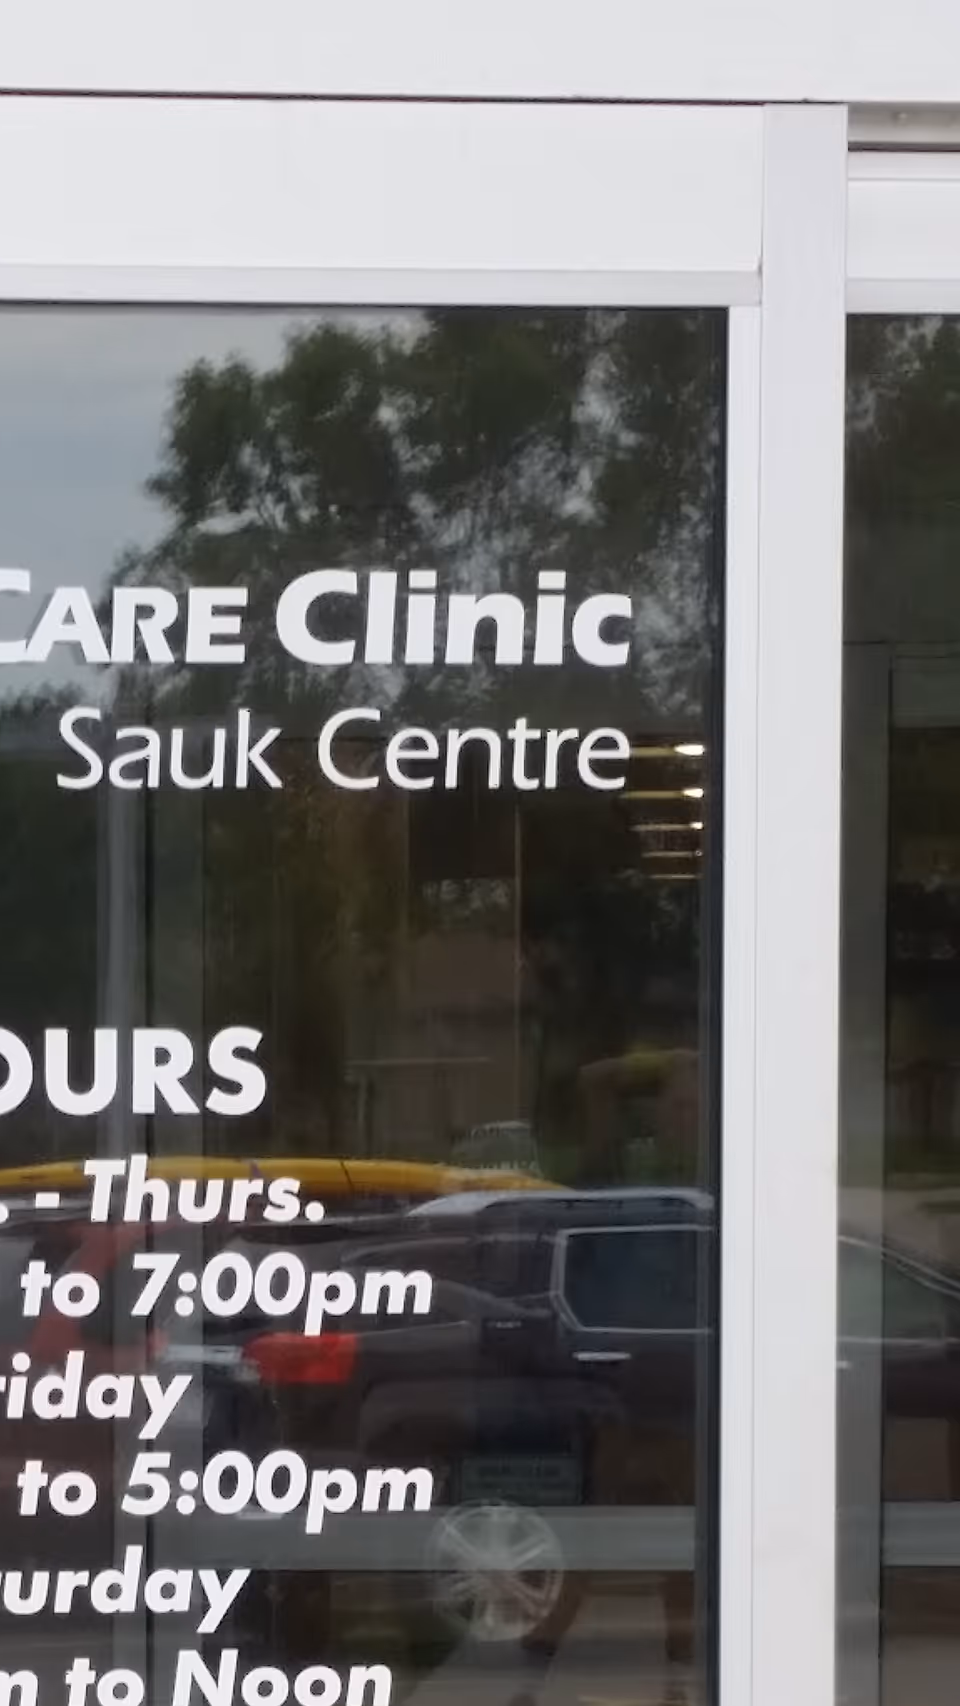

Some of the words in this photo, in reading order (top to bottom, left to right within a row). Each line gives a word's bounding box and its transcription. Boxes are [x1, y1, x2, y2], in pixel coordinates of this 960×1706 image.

[274, 568, 633, 667] Clinic
[55, 706, 283, 790] Sauk
[317, 706, 631, 790] Centre
[82, 1153, 326, 1224] Thurs.
[19, 1260, 101, 1318] to
[130, 1250, 434, 1338] 7:00pm
[16, 1459, 98, 1517] to
[120, 1449, 434, 1535] 5:00pm
